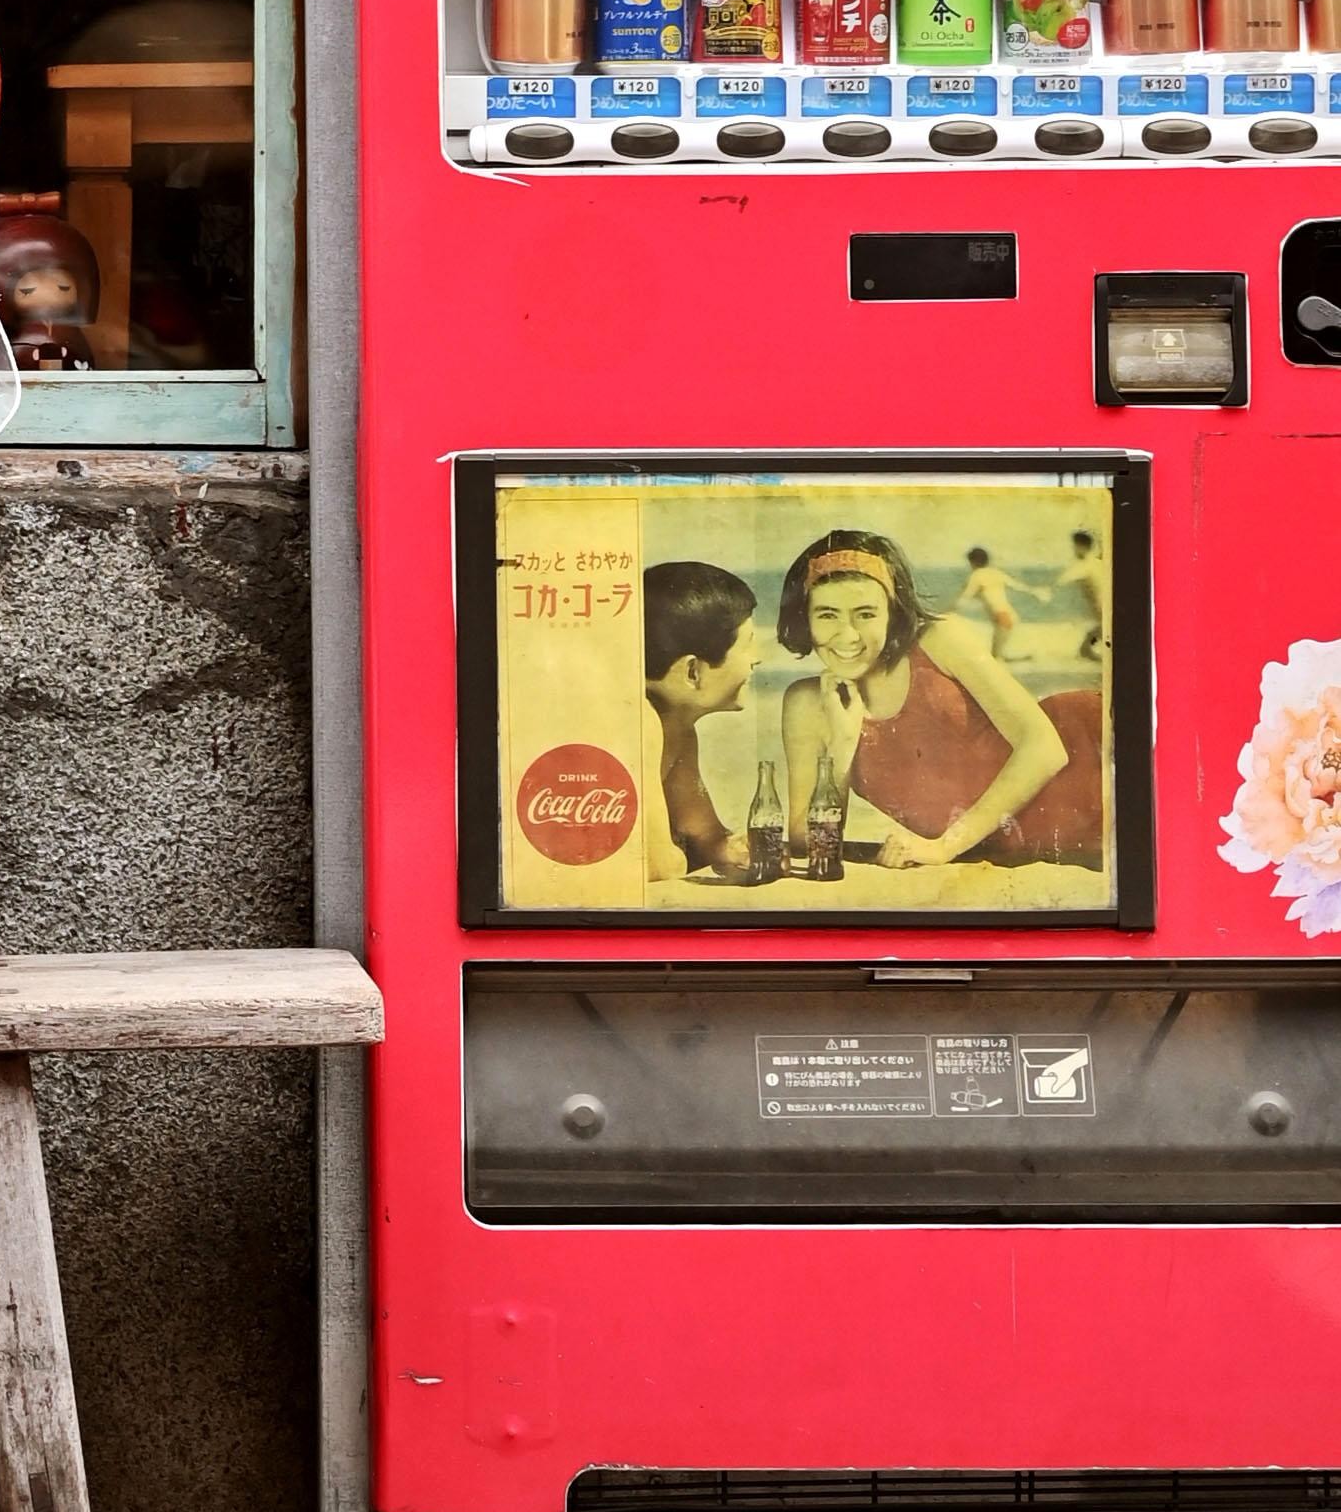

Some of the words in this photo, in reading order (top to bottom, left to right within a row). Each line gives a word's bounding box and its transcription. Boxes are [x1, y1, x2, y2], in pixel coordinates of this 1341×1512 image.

[612, 28, 659, 37] SUNTORY
[967, 241, 1010, 262] 販売中
[575, 551, 633, 571] さわやか
[513, 583, 633, 619] コカ・コーラ
[558, 773, 598, 783] DRINK
[527, 787, 628, 824] Coca-Cola
